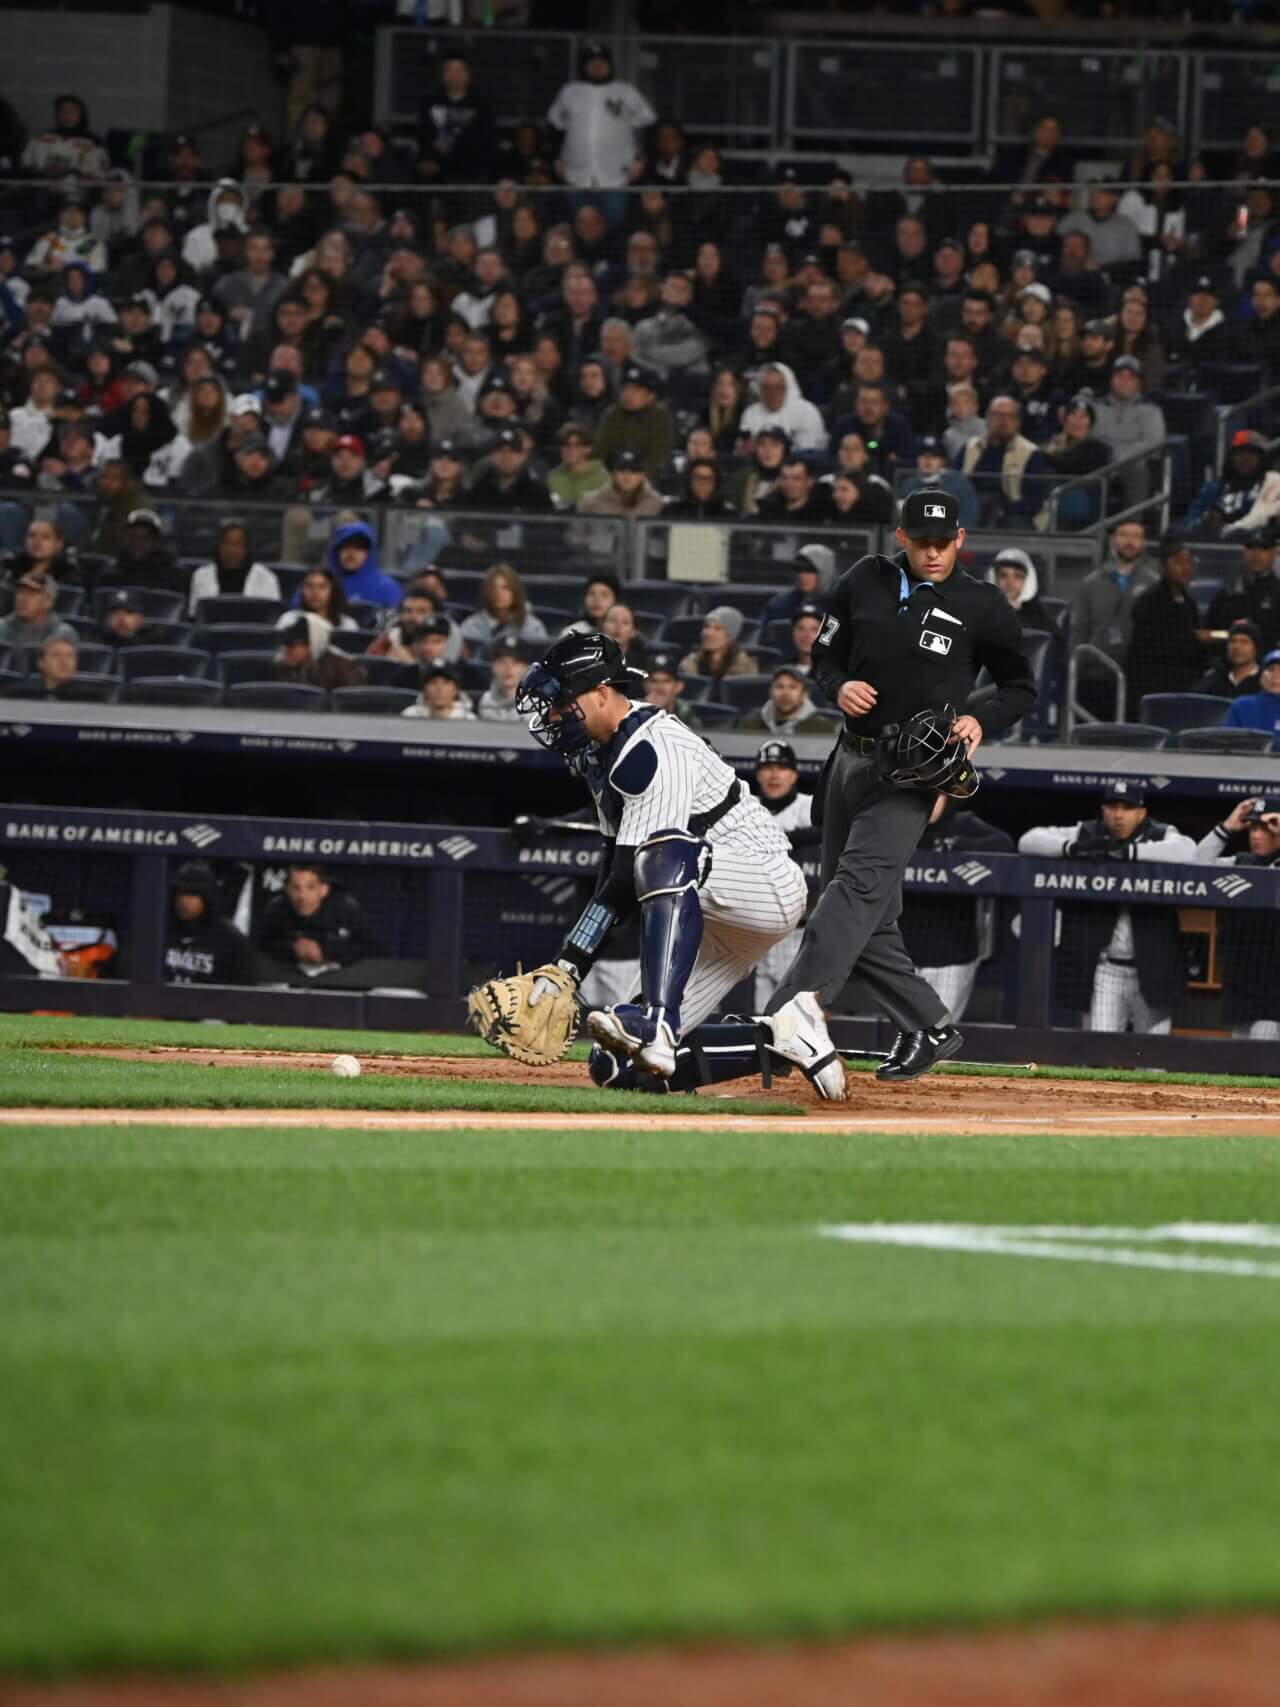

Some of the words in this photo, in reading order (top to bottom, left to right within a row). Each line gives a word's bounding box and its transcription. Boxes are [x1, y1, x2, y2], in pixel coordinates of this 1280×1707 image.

[1053, 773, 1082, 784] BANK
[1085, 775, 1098, 785] OF
[1218, 783, 1247, 794] BANK
[1249, 784, 1263, 795] OF
[6, 822, 59, 842] BANK
[63, 826, 89, 842] OF
[90, 827, 178, 846] AMERICA
[263, 836, 316, 853] BANK
[319, 839, 345, 855] OF
[347, 841, 434, 858] AMERICA
[519, 849, 572, 865] BANK
[575, 851, 600, 866] OF
[904, 867, 949, 884] RICA
[1034, 873, 1087, 891] BANK
[1091, 876, 1116, 892] OF
[1119, 878, 1208, 897] AMERICA
